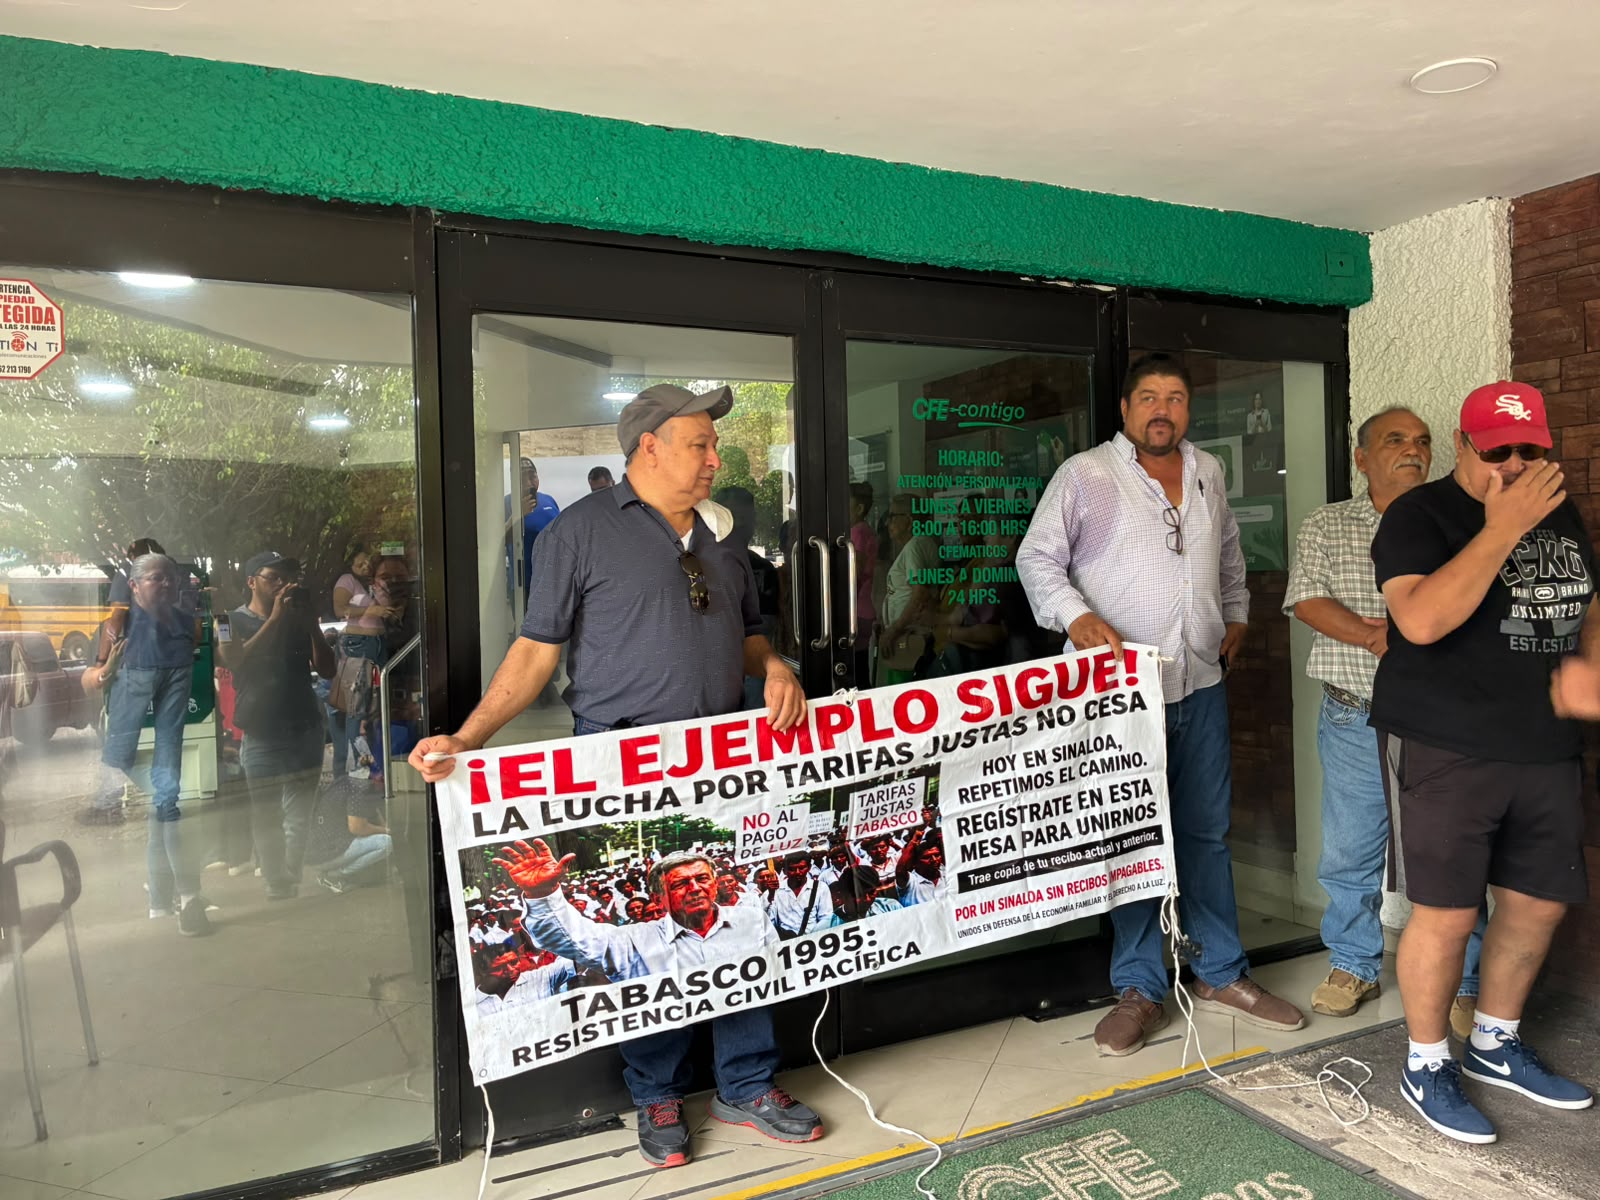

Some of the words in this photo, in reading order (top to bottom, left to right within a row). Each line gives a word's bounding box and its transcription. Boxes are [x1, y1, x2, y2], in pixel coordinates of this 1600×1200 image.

[938, 449, 1004, 467] HORARIO:
[896, 471, 953, 489] ATENCIÓN
[911, 497, 957, 515] LUNES
[961, 497, 972, 514] A
[974, 498, 1032, 515] VIERNES
[912, 520, 942, 537] 8:00
[945, 521, 957, 536] A
[961, 520, 998, 536] 16:00
[938, 544, 1008, 559] CFEMATICOS
[909, 567, 955, 585] LUNES
[947, 589, 965, 606] 24
[1561, 583, 1589, 597] BRAND
[1511, 602, 1582, 619] UNLIMITED
[467, 748, 597, 805] ¡EL
[619, 688, 939, 787] EJEMPLO
[956, 648, 1140, 724] SIGUE!
[472, 805, 529, 838] LA
[541, 785, 682, 826] LUCHA
[693, 769, 769, 805] POR
[777, 742, 914, 788] TARIFAS
[922, 715, 1028, 759] JUSTAS
[1036, 704, 1076, 732] NO
[1084, 690, 1148, 722] CESA
[982, 754, 1017, 776] HOY
[1023, 749, 1047, 769] EN
[1052, 734, 1123, 763] SINALOA,
[958, 771, 1055, 805] REPETIMOS
[1059, 767, 1076, 784] EL
[1079, 752, 1147, 778] CAMINO.
[858, 782, 916, 808] TARIFAS
[743, 812, 771, 831] NO
[777, 808, 799, 824] AL
[860, 797, 914, 822] JUSTAS
[956, 795, 1073, 838] REGÍSTRATE
[1077, 787, 1104, 810] EN
[1109, 778, 1154, 804] ESTA
[854, 810, 918, 836] TABASCO
[960, 835, 1017, 863] MESA
[1021, 821, 1073, 849] PARA
[1076, 801, 1157, 836] UNIRNOS
[740, 846, 761, 859] DE
[768, 838, 803, 854] LUZ
[742, 826, 788, 847] PAGO
[968, 872, 991, 886] Trae
[993, 864, 1021, 879] copia
[1023, 861, 1036, 872] de
[1037, 857, 1049, 869] tu
[1050, 850, 1082, 866] recibo
[1085, 843, 1115, 860] actual
[1115, 841, 1121, 853] y
[1122, 831, 1159, 849] anterior.
[955, 904, 977, 922] POR
[980, 900, 995, 915] UN
[998, 889, 1044, 911] SINALOA
[1046, 883, 1064, 900] SIN
[1066, 874, 1108, 896] RECIBOS
[1109, 858, 1165, 884] IMPAGABLES.
[957, 921, 982, 939] UNIDOS
[983, 920, 992, 931] EN
[993, 915, 1022, 930] DEFENSA
[1022, 912, 1031, 921] DE
[1031, 911, 1041, 920] LA
[1042, 903, 1075, 919] ECONOMÍA
[1075, 896, 1102, 910] FAMILIAR
[1112, 884, 1135, 898] DERECHO
[1142, 881, 1151, 889] LA
[1151, 878, 1166, 888] LUZ.
[561, 954, 767, 1024] TABASCO
[777, 926, 877, 971] 1995:
[512, 999, 715, 1067] RESISTENCIA
[725, 975, 796, 1009] CIVIL
[803, 940, 922, 987] PACÍFICA
